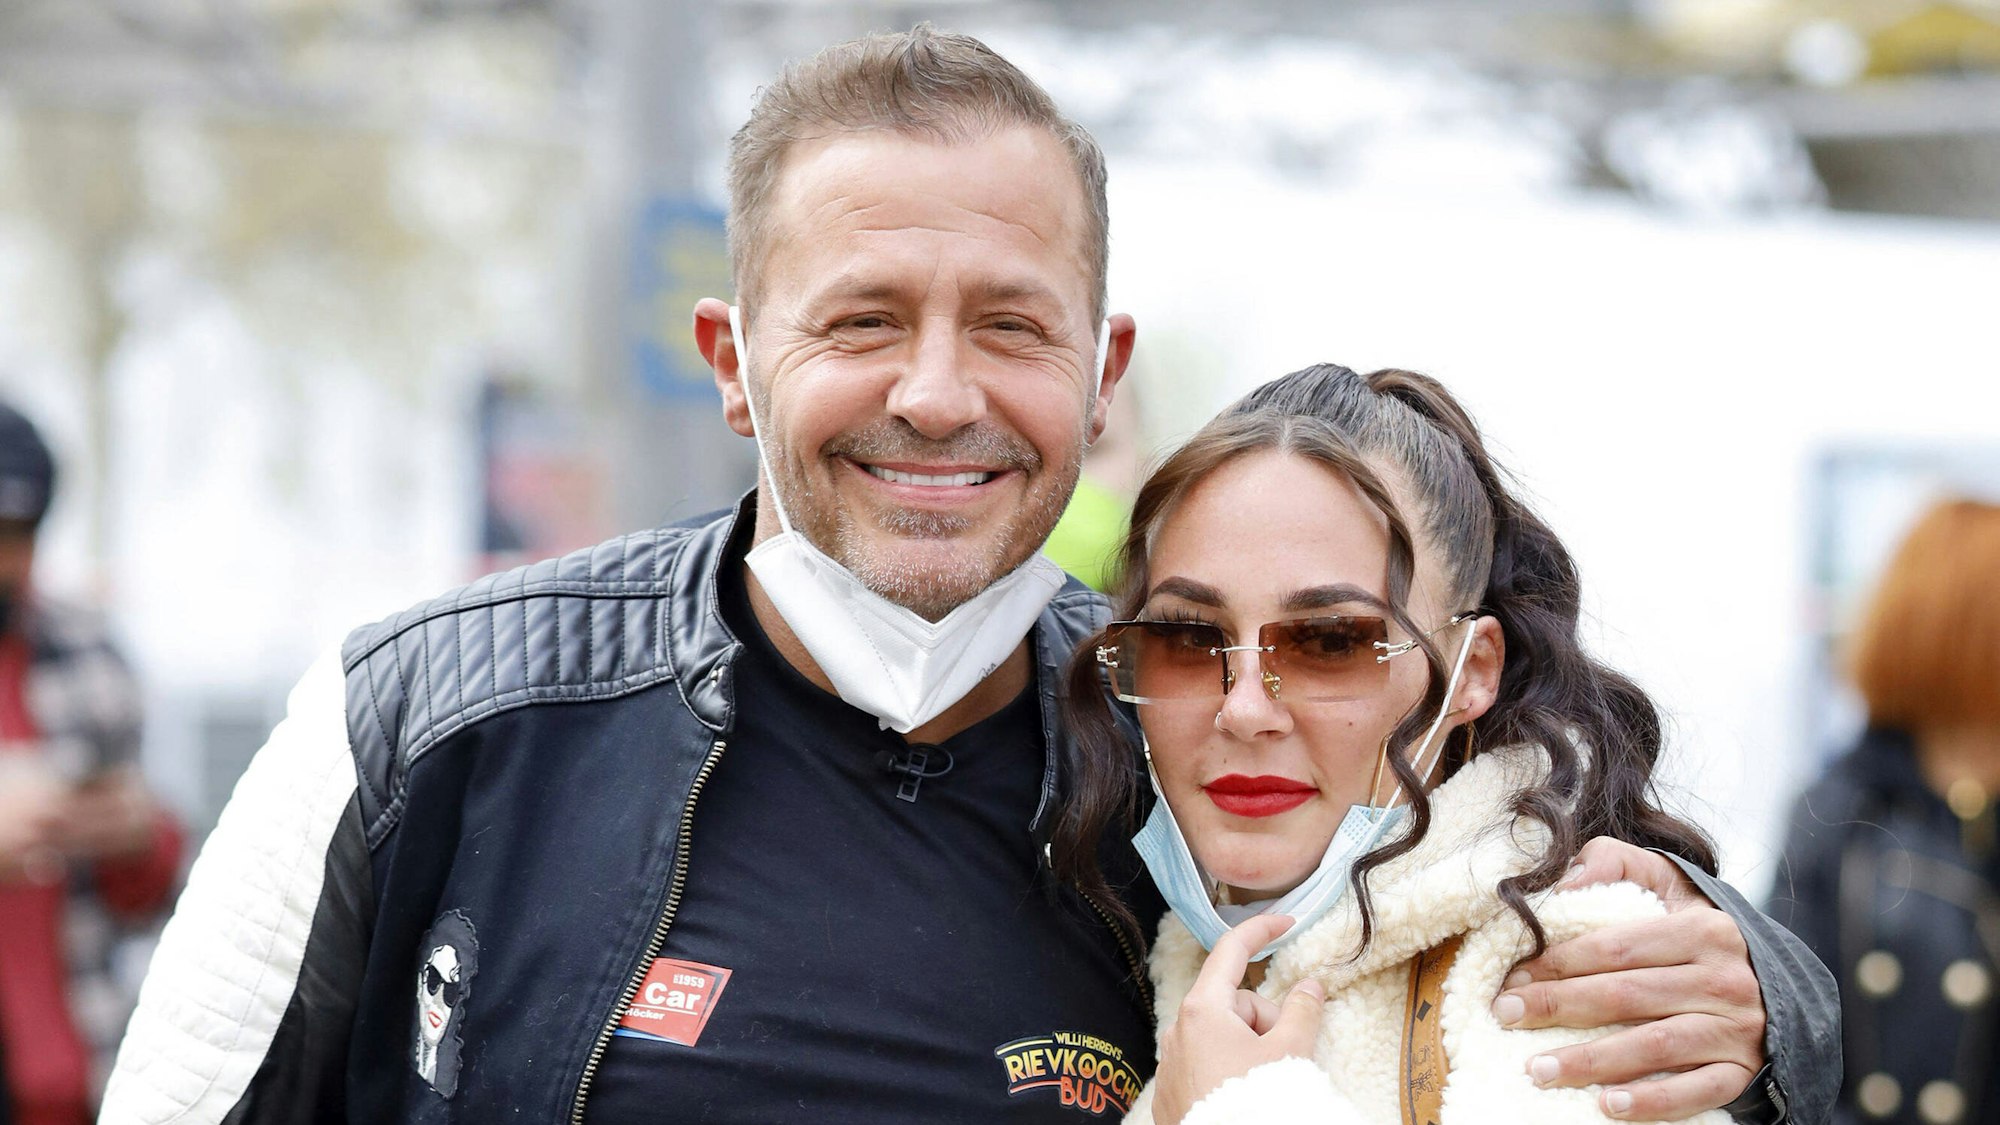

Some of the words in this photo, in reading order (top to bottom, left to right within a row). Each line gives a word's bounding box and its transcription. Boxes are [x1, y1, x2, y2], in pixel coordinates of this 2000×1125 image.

[645, 982, 701, 1010] Car
[1054, 1032, 1082, 1047] WILLI
[1082, 1035, 1123, 1061] HERREN'S
[1061, 1076, 1106, 1114] BUD
